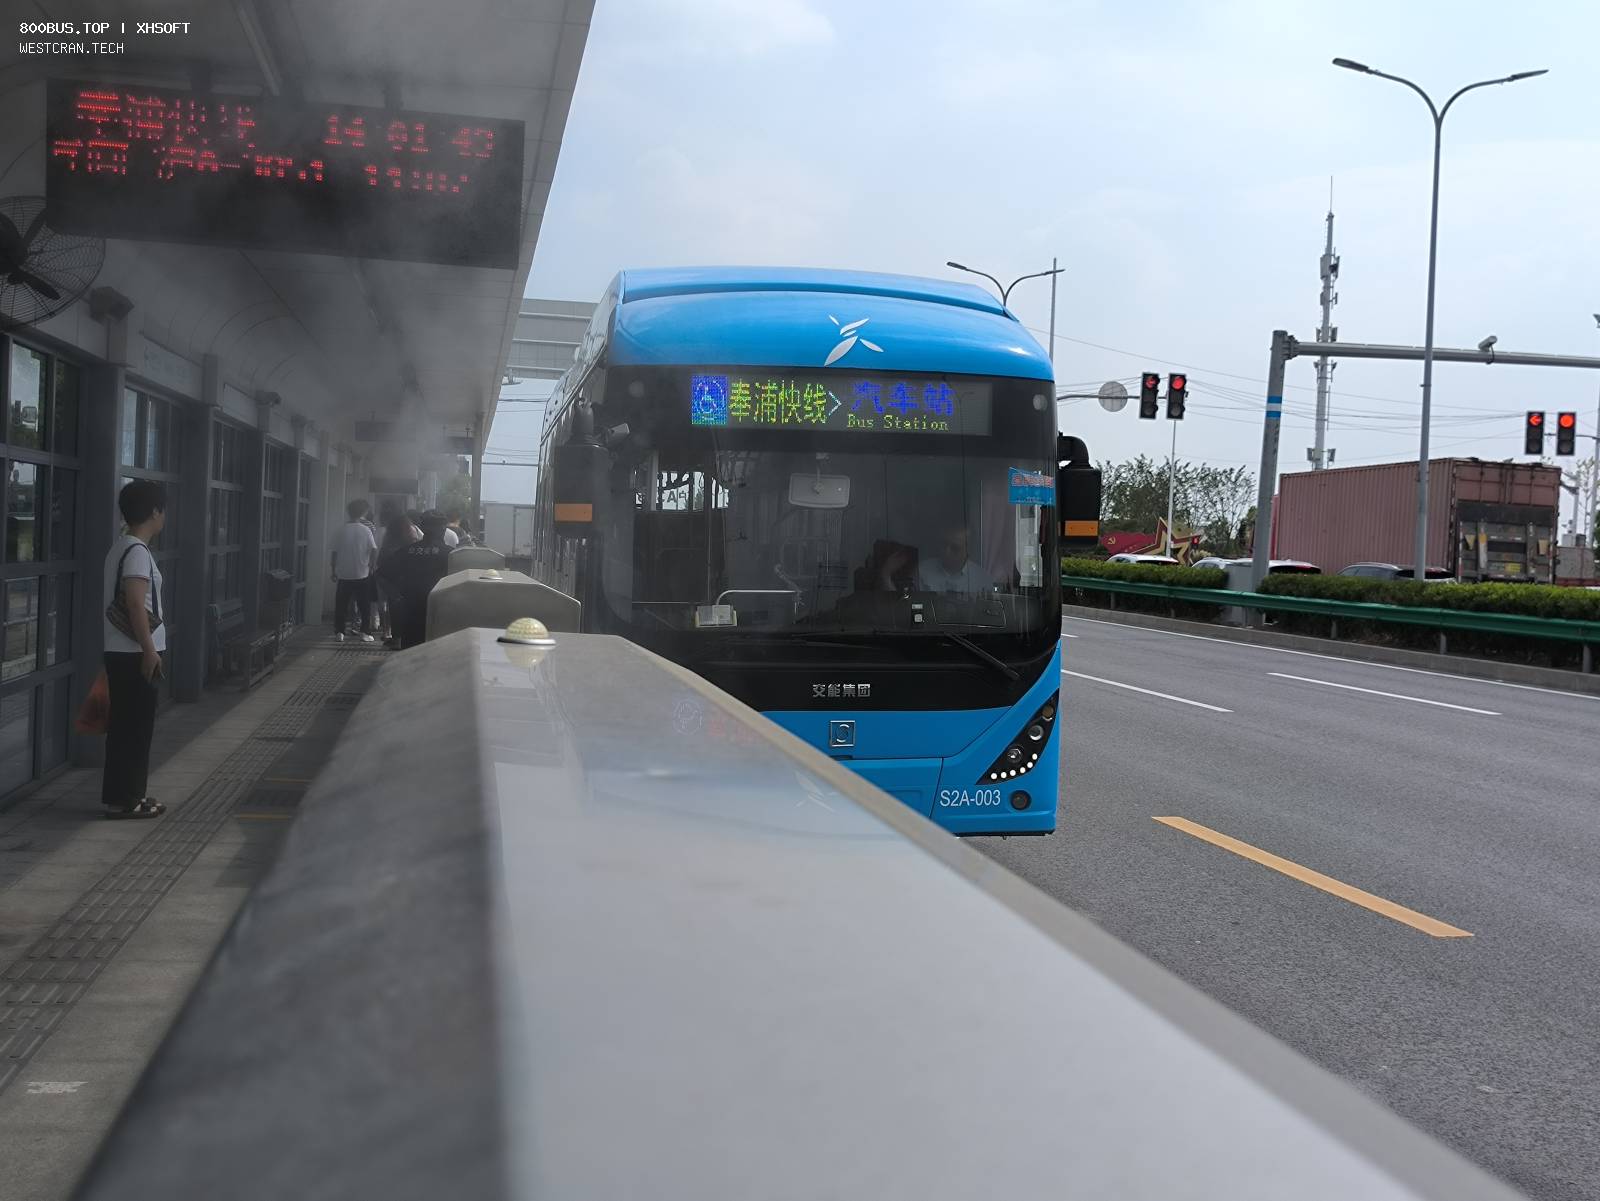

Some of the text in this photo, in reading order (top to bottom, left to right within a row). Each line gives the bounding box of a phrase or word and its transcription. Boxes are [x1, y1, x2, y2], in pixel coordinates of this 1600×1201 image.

[729, 378, 827, 425] 奉浦快线
[850, 380, 956, 416] 汽车站
[846, 413, 949, 432] Bus Station
[811, 682, 871, 699] 交能集团
[938, 788, 1002, 808] S2A-003
